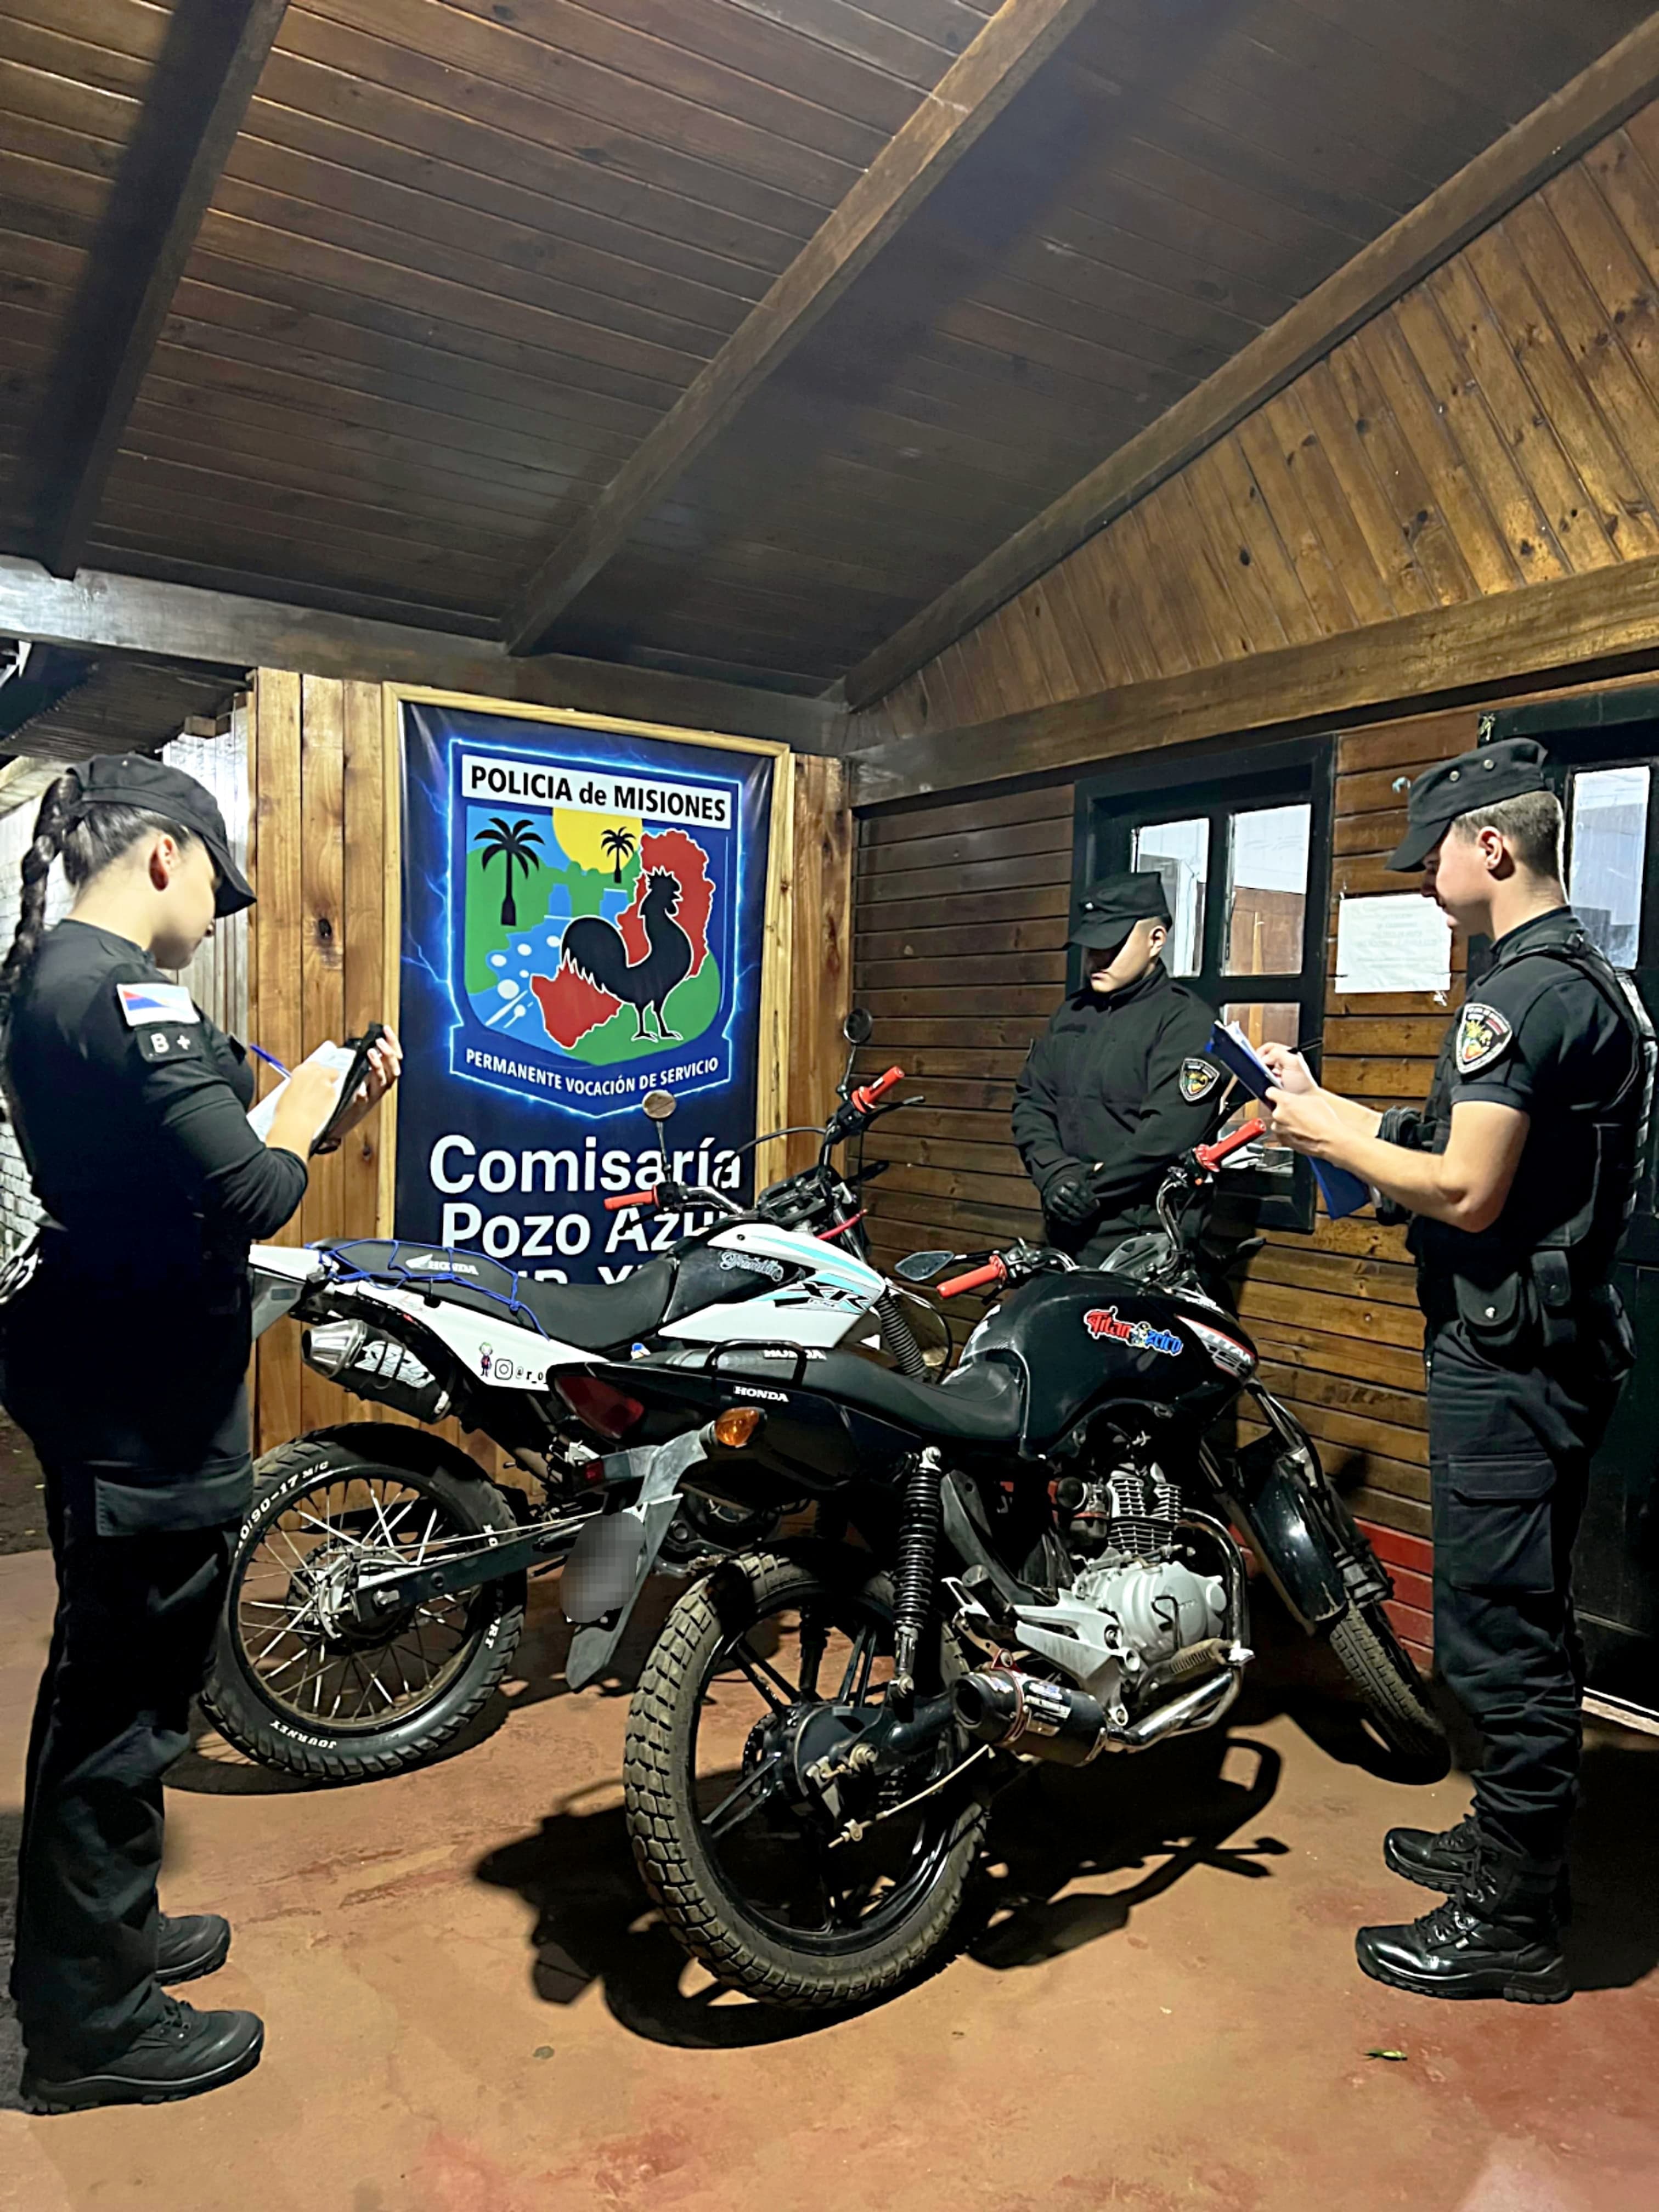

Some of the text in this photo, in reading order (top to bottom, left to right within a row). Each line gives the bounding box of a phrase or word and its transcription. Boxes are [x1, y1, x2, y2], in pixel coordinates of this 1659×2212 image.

[471, 765, 726, 822] POLICIA de MISIONES
[466, 1048, 719, 1097] PERMANENTE VOCACIÓN DE SERVICIO
[430, 1134, 741, 1194] Comisaría
[442, 1202, 729, 1259] Pozo Azu
[428, 1261, 479, 1276] HONDA
[733, 1385, 789, 1403] HONDA
[269, 1719, 337, 1749] JOURNEY
